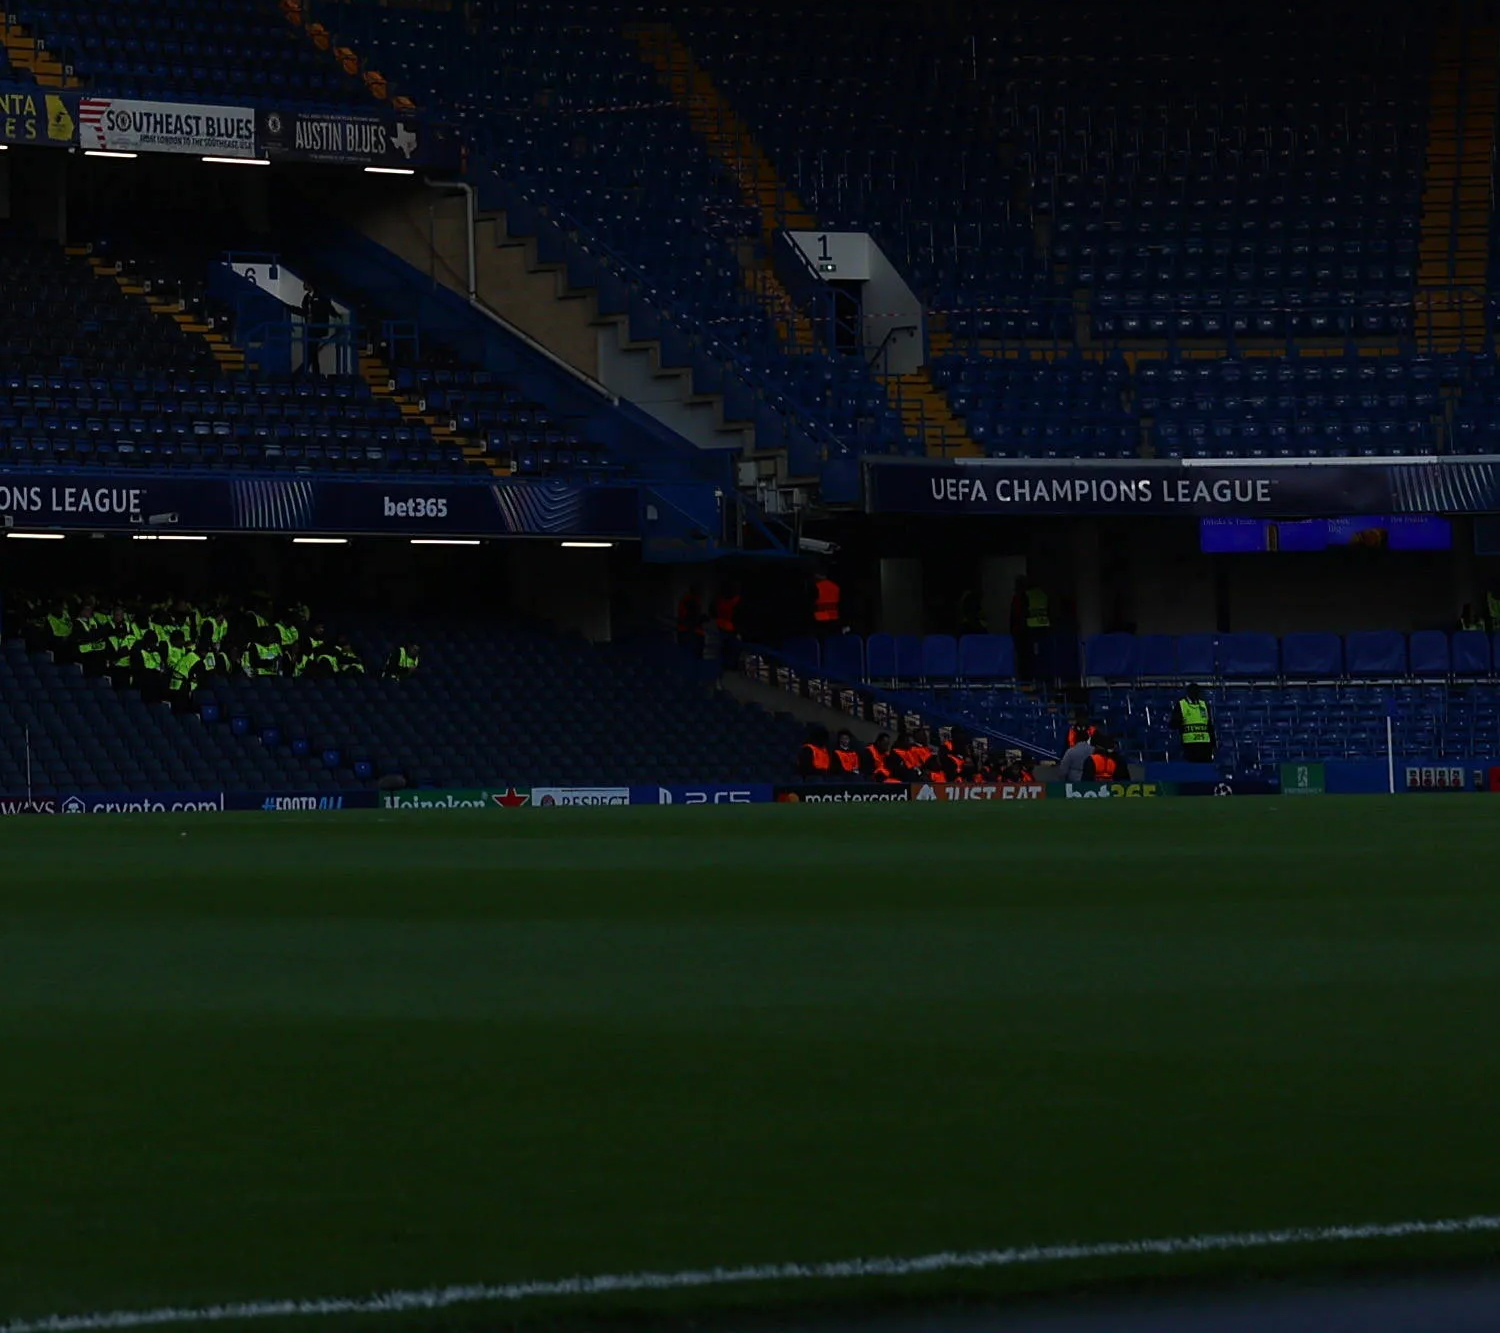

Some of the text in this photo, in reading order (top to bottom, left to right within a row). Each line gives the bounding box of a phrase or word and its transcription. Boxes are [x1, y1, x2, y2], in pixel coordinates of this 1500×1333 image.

[106, 110, 253, 140] SOUTHEAST BLUES
[295, 121, 387, 154] AUSTIN BLUES
[818, 235, 833, 261] 1
[931, 477, 988, 501] UEFA
[995, 479, 1153, 503] CHAMPIONS
[383, 496, 448, 517] bet365
[805, 789, 909, 802] mastercard
